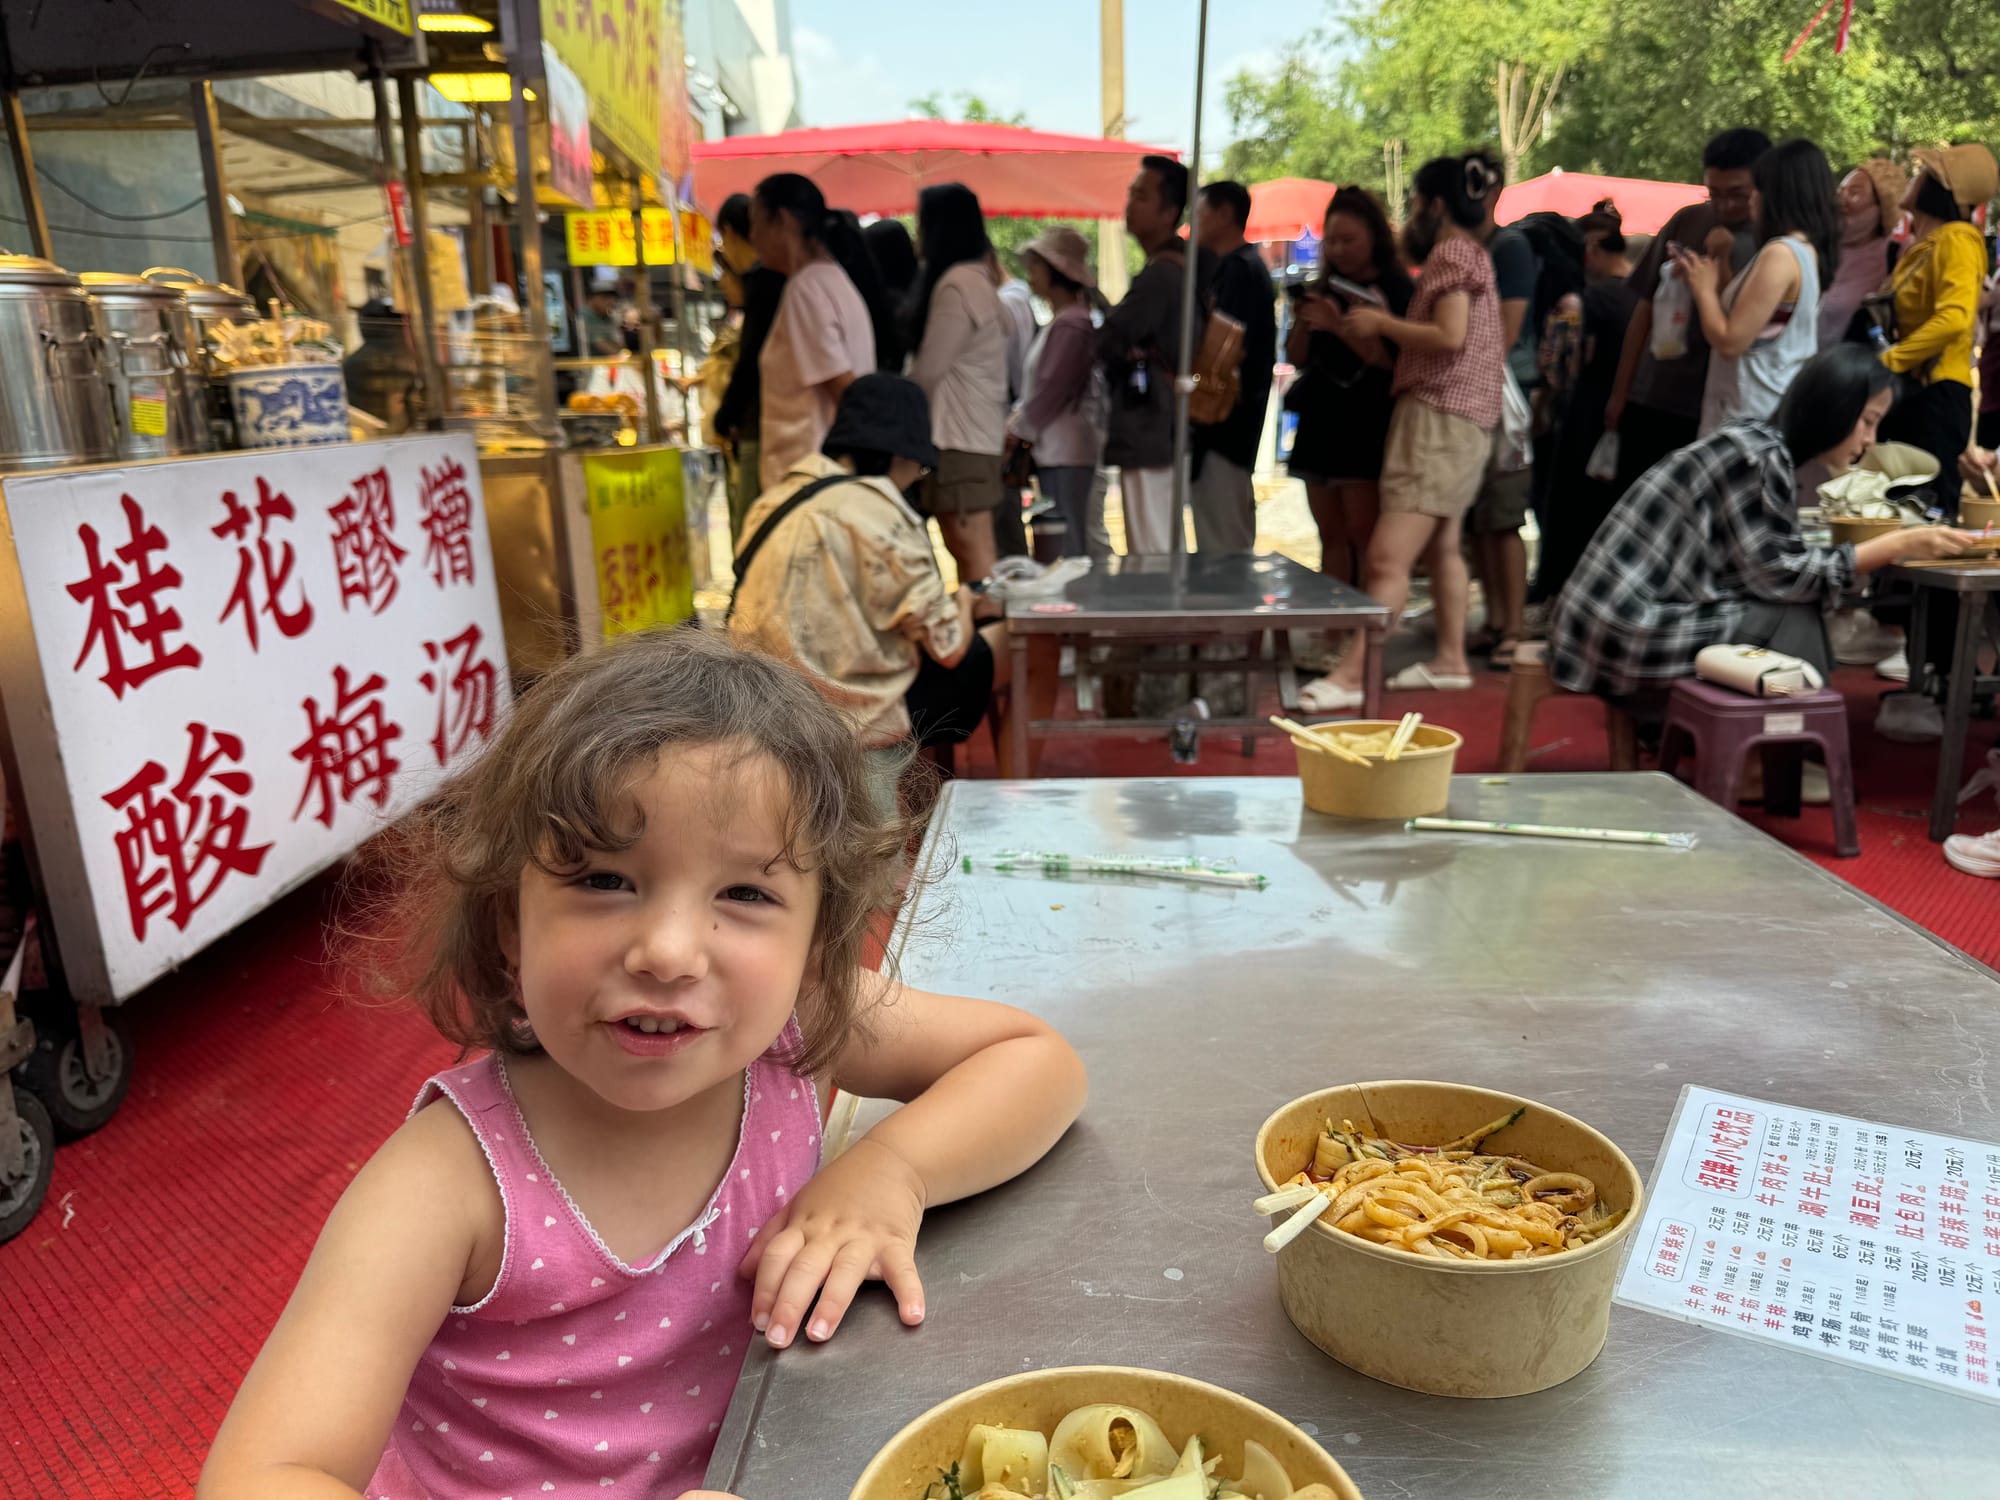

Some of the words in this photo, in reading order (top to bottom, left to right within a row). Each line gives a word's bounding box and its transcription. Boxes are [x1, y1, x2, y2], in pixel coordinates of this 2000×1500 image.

[66, 454, 475, 701] 桂花醪糟
[102, 622, 497, 942] 酸梅汤
[1695, 1108, 1755, 1192] 招牌小吃饮品
[1904, 1139, 1924, 1169] 20元/个
[1944, 1147, 1965, 1178] 20元/个
[1755, 1161, 1791, 1206] 牛肉饼
[1797, 1171, 1832, 1219] 涮牛肚
[1849, 1180, 1882, 1230] 涮豆皮
[1894, 1192, 1926, 1240] 肚包肉
[1938, 1184, 1970, 1250] 胡辣羊蹄
[1653, 1223, 1689, 1277] 招牌烧烤
[1684, 1284, 1708, 1311] 牛肉
[1708, 1206, 1727, 1231] 2元/串
[1711, 1291, 1734, 1316] 羊肉
[1732, 1210, 1751, 1235] 3元/串
[1736, 1296, 1760, 1323] 牛筋
[1757, 1216, 1775, 1242] 2元/串
[1858, 1239, 1876, 1265] 3元/串
[1884, 1245, 1902, 1271] 3元/串
[1911, 1251, 1928, 1283] 20元/个
[1938, 1256, 1955, 1287] 10元/个
[1763, 1303, 1787, 1330] 羊排
[1782, 1222, 1800, 1248] 5元/串
[1791, 1310, 1814, 1339] 鸡翅
[1807, 1227, 1824, 1253] 8元/串
[1818, 1317, 1842, 1346] 烤肠
[1832, 1233, 1851, 1259] 6元/个
[1964, 1262, 1983, 1294] 12元/个
[1847, 1311, 1872, 1353] 鸡脆骨
[1875, 1316, 1900, 1362] 烤青虾
